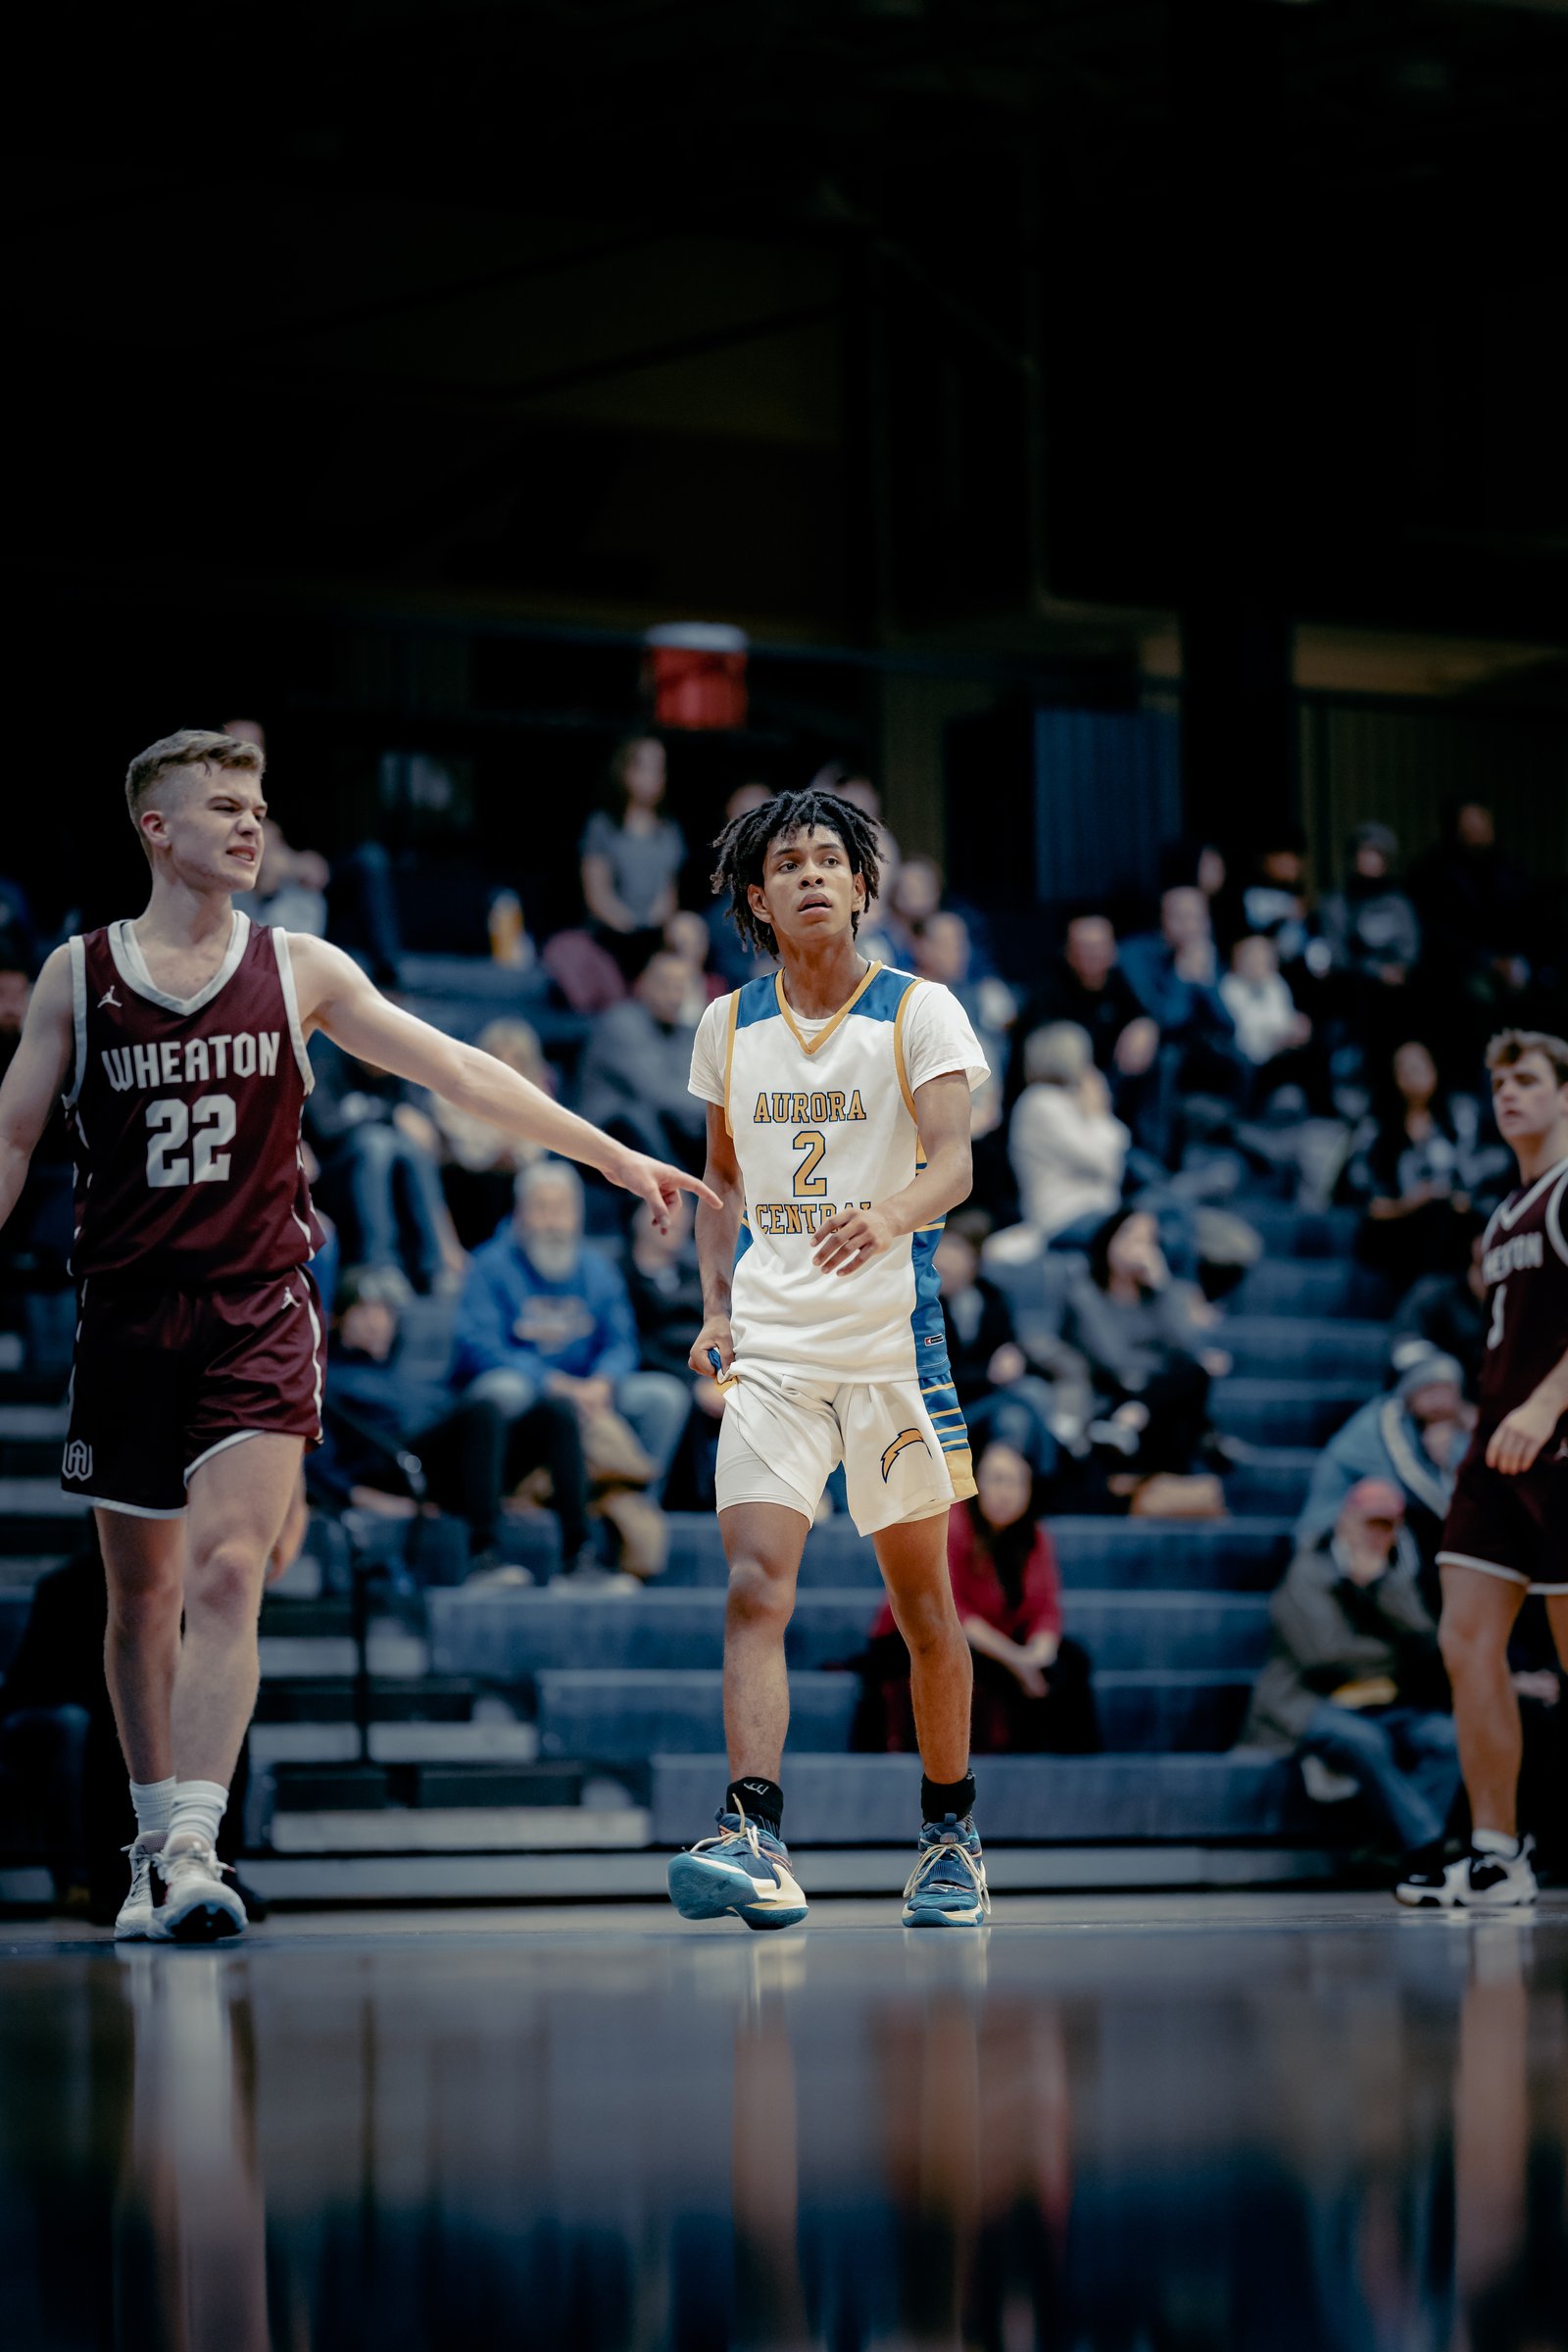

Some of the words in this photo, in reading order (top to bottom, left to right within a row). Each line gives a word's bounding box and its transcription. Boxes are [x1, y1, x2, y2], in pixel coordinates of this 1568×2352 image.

[101, 1032, 280, 1092] WHEATON
[754, 1090, 867, 1123] AURORA
[146, 1094, 236, 1188] 22
[792, 1130, 827, 1197] 2
[755, 1201, 871, 1235] CENTR
